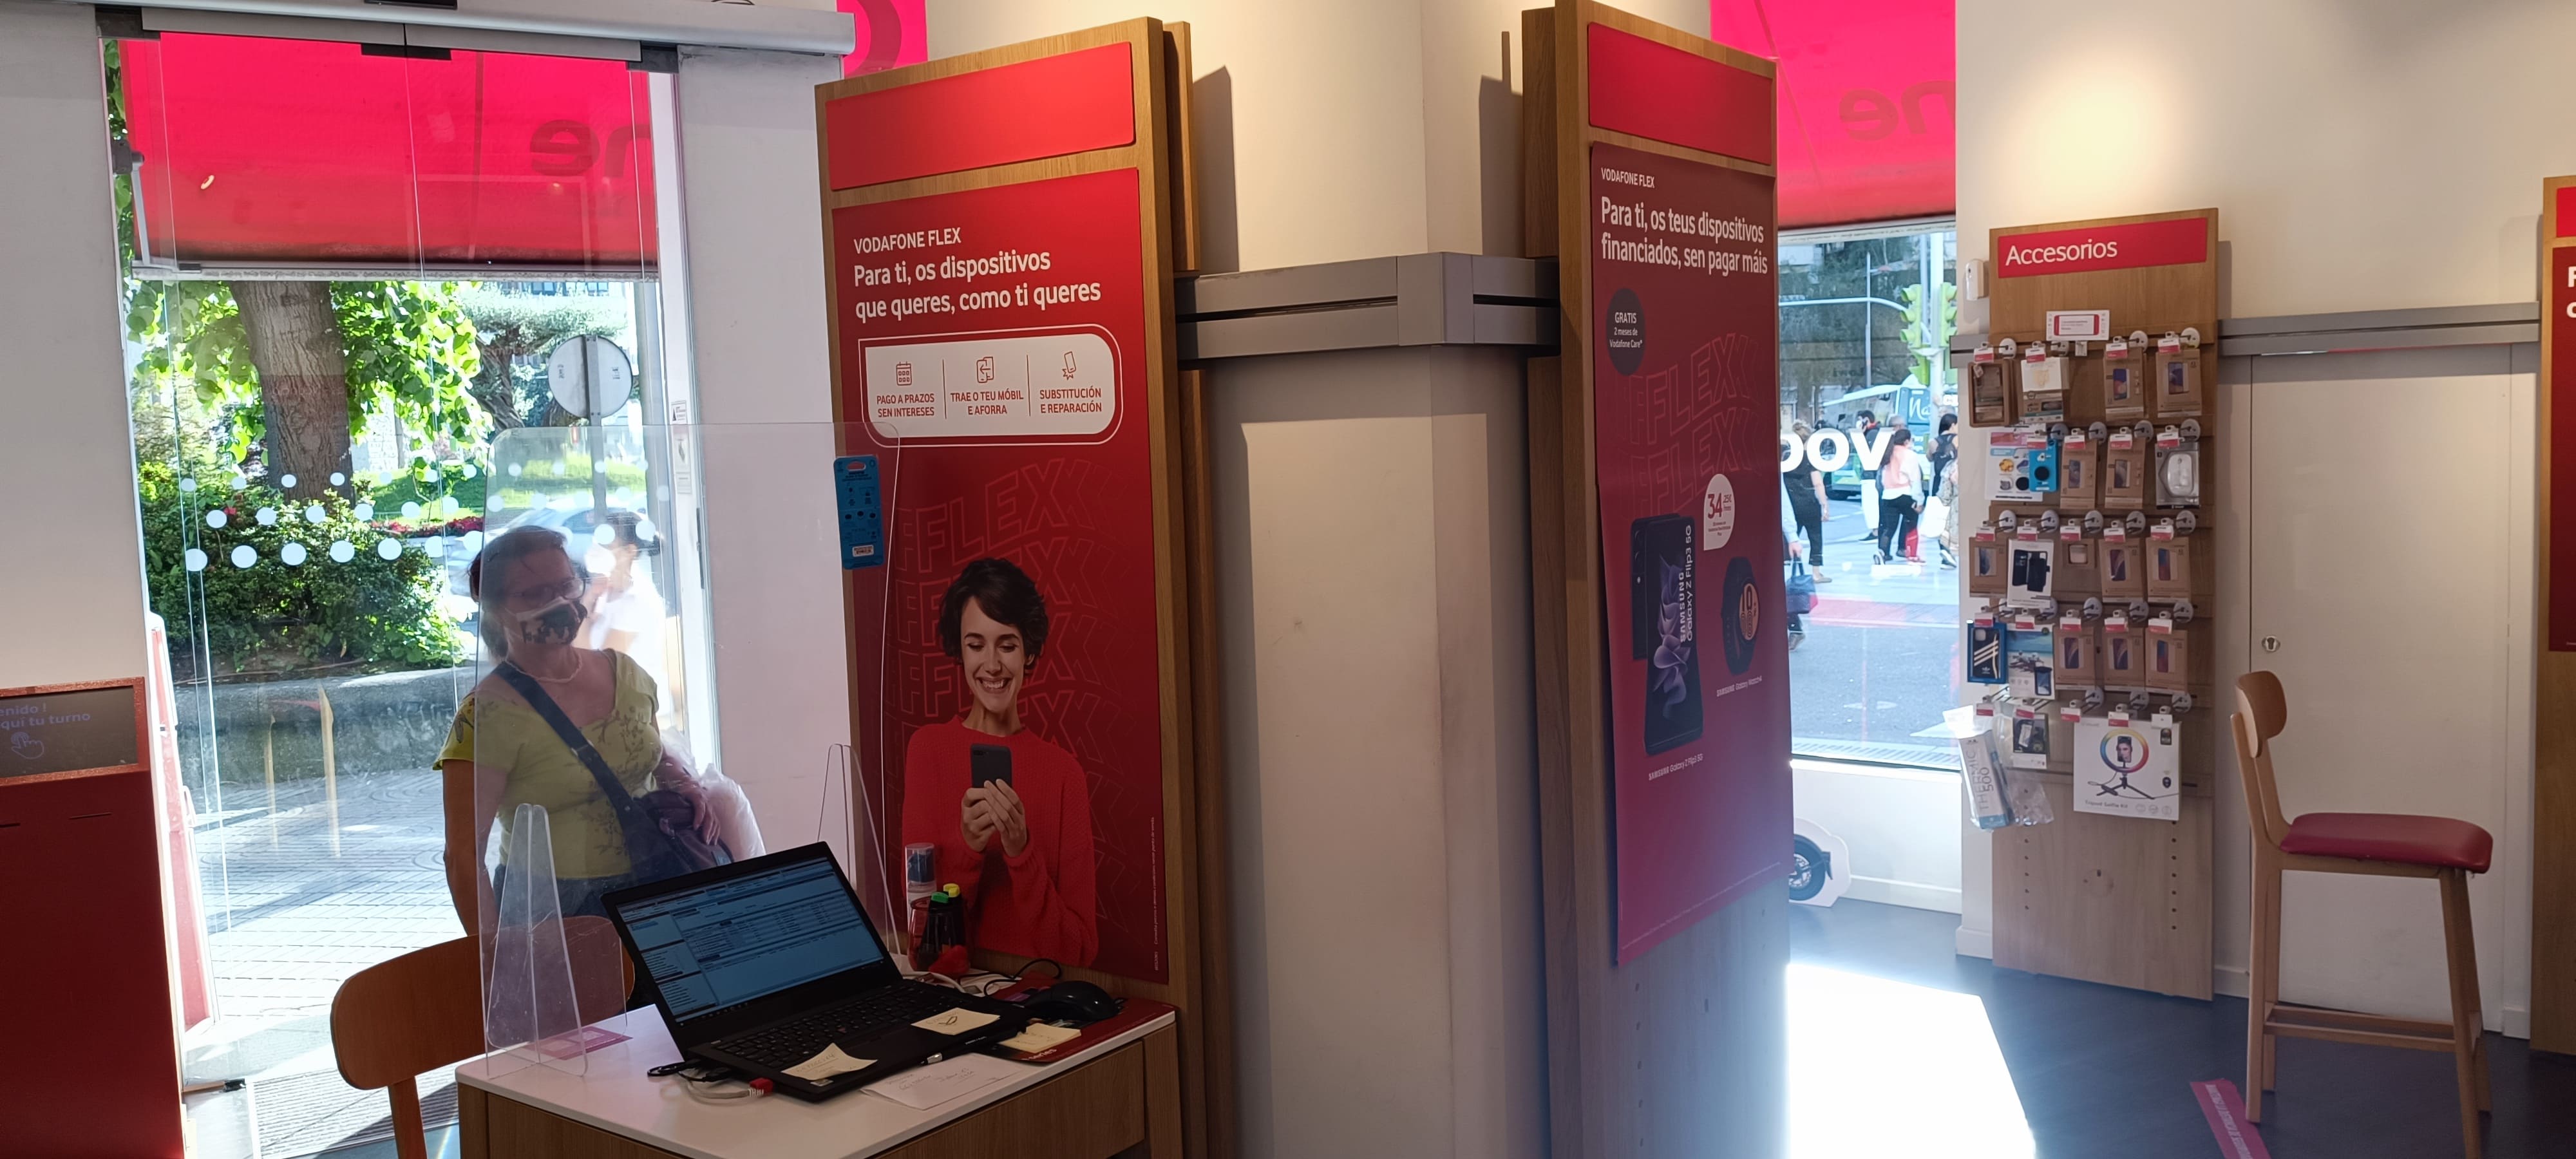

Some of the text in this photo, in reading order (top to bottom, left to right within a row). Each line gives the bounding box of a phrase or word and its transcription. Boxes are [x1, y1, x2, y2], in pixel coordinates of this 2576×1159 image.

[1601, 167, 1654, 188] VODAFONE FLEX
[1602, 196, 1764, 244] Para ti, os teus dispositivos
[853, 227, 961, 254] VODAFONE FLEX
[1602, 231, 1768, 277] financiados, sen pagar máis
[2005, 239, 2117, 266] Accesorios
[854, 249, 1051, 287] Para ti, os dispositivos
[855, 282, 1101, 324] que queres, como ti queres
[1615, 312, 1637, 323] GRATIS
[1609, 339, 1631, 348] Vodafone
[876, 393, 935, 404] PAGO A PRAZOS
[951, 388, 1024, 402] TRAE O TEU MÓBIL
[1039, 385, 1102, 399] SUBSTITUCIÓN
[878, 406, 935, 417] SEN INTERESES
[967, 404, 1008, 415] E AFORRA
[1040, 400, 1102, 413] E REPARACIÓN
[1707, 493, 1723, 520] 34
[1685, 525, 1692, 544] 5G
[1685, 547, 1693, 578] Flip3
[1685, 581, 1692, 589] Z
[29, 717, 44, 726] tu
[49, 713, 91, 724] turno
